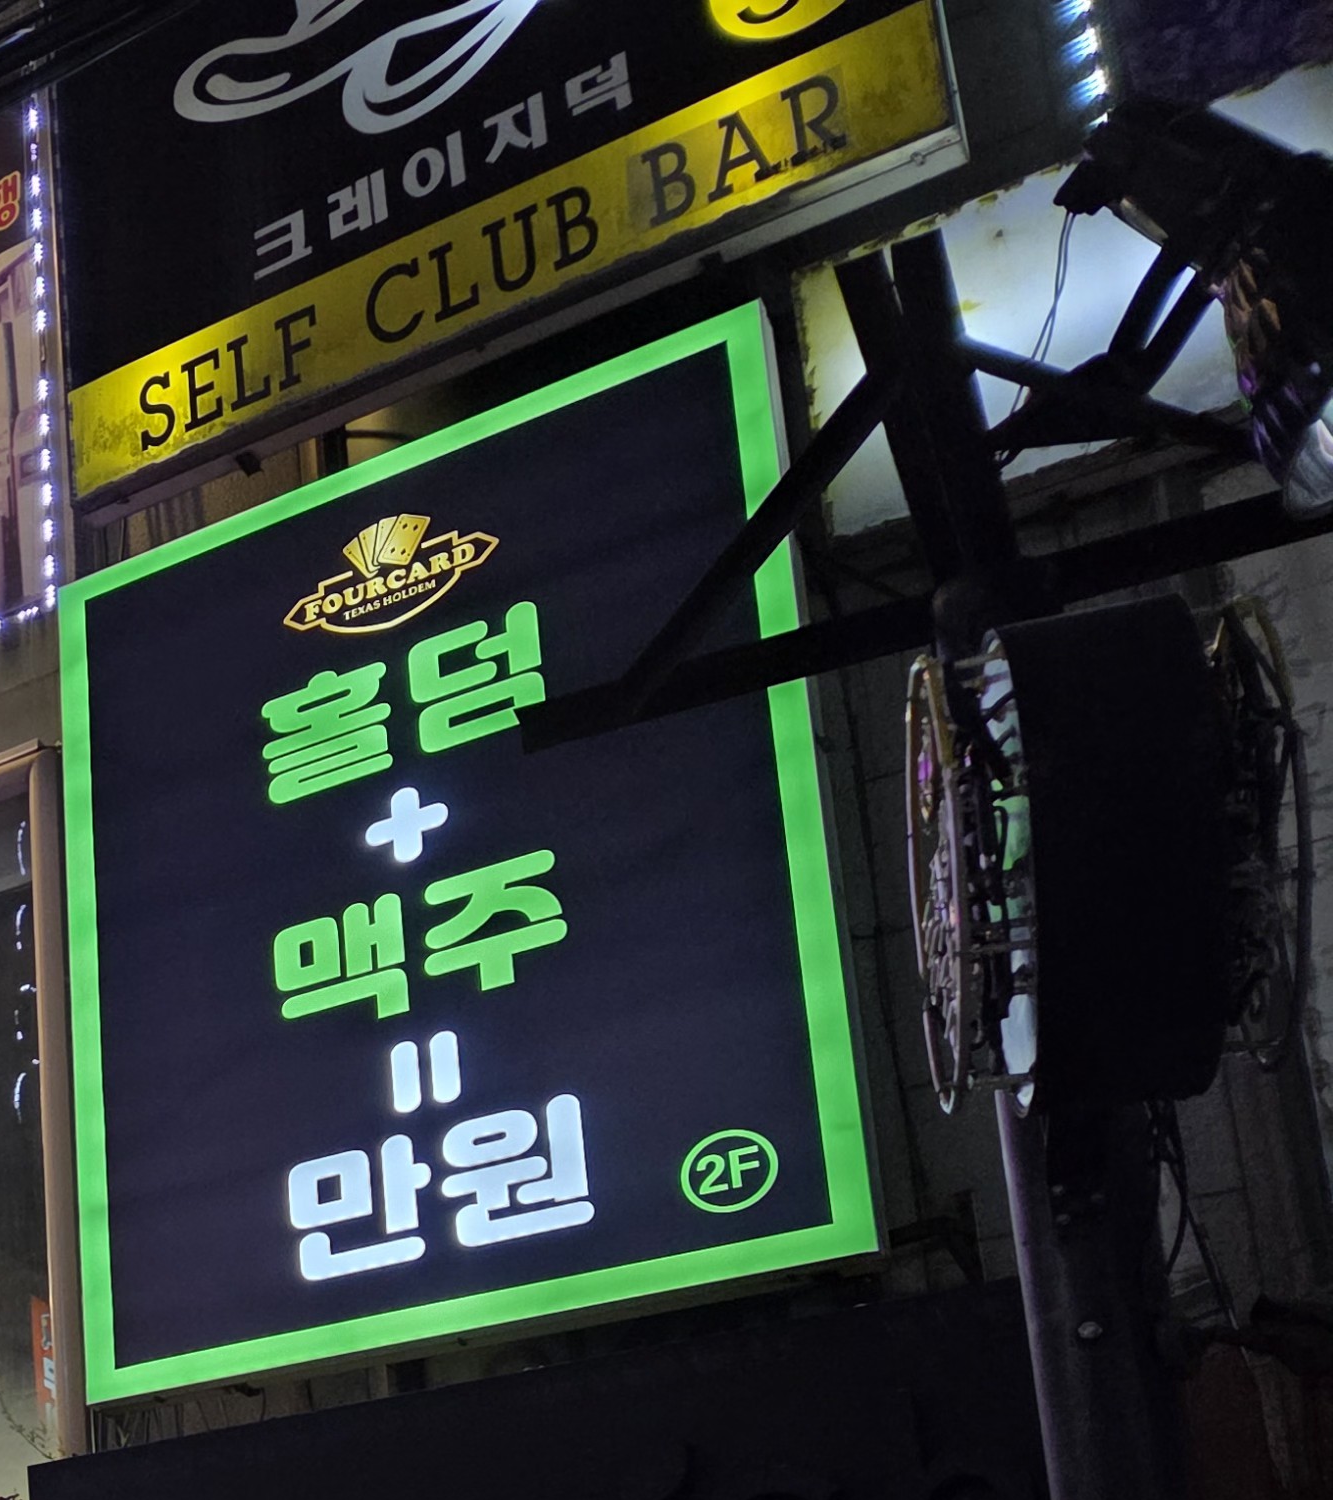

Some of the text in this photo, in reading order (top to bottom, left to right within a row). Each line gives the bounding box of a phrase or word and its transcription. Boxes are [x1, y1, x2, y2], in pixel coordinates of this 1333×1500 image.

[253, 51, 635, 281] 크레이지덕
[137, 74, 849, 452] SELF CLUB BAR
[302, 538, 477, 624] FOURCARD
[343, 578, 438, 621] TEXAS HOLDEM
[259, 601, 547, 805] 홀덤
[272, 849, 568, 1020] 맥주
[288, 1094, 595, 1282] 만원
[696, 1146, 761, 1196] 2F
